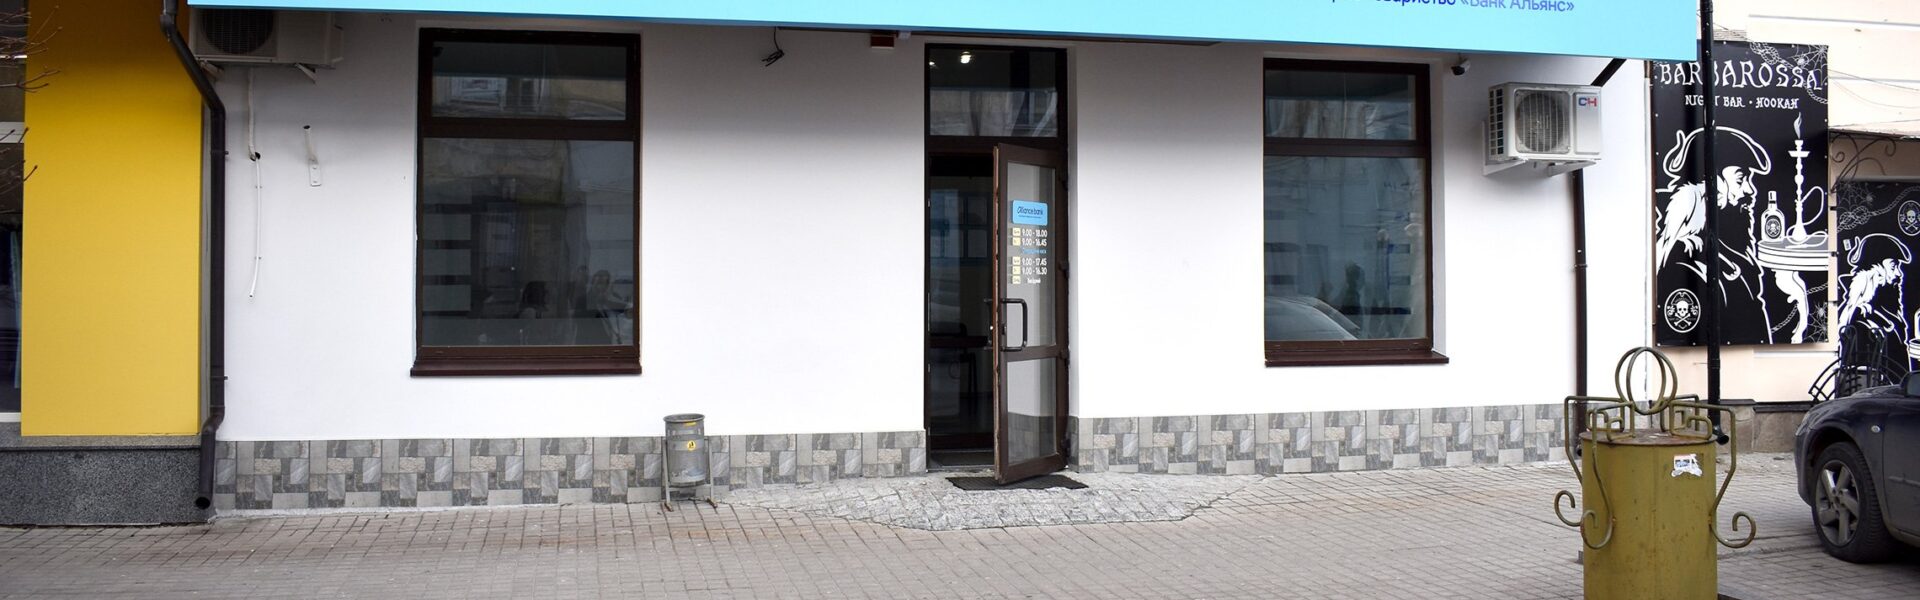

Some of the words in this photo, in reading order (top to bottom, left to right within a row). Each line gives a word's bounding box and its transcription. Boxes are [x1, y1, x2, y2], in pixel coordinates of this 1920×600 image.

[1509, 0, 1575, 12] Альянс»
[1578, 97, 1597, 107] CH
[1685, 94, 1720, 106] NIGT
[1723, 96, 1745, 108] BAR
[1755, 97, 1799, 109] HOOKAH
